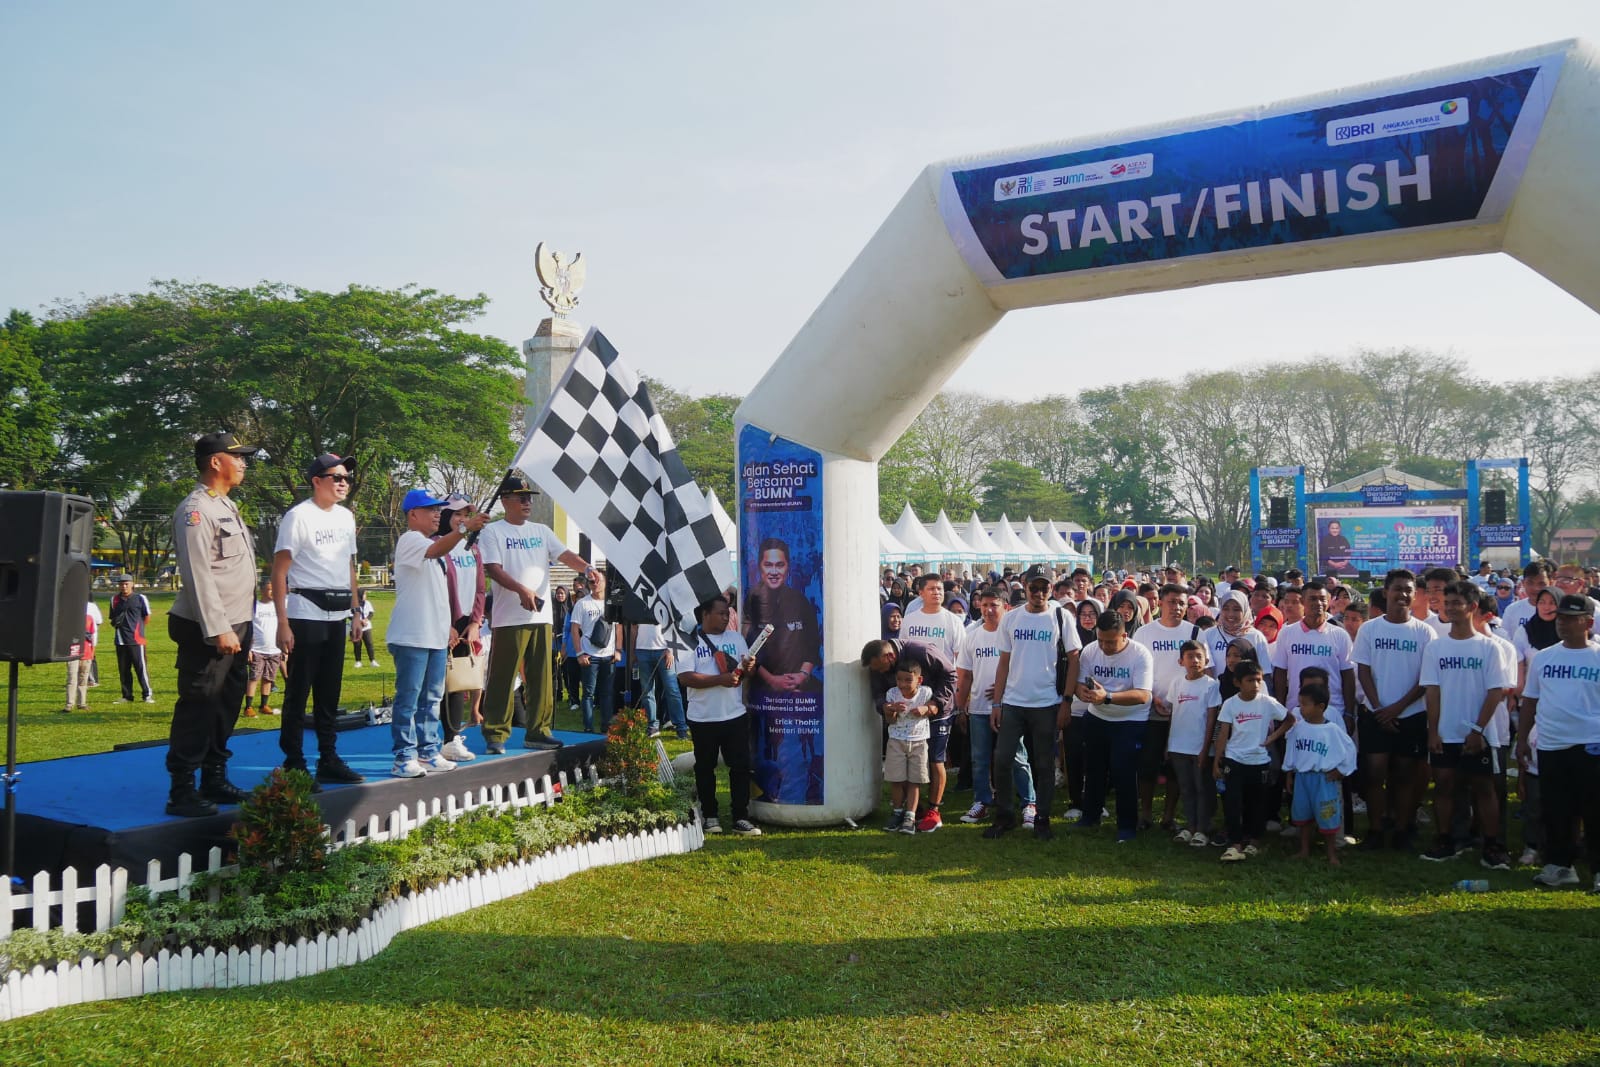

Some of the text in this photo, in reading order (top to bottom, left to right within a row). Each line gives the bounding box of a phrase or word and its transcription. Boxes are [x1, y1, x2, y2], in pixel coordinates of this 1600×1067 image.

[1351, 122, 1374, 137] BRI
[1382, 120, 1414, 130] ANGKASA
[1415, 116, 1433, 124] PURA
[1020, 155, 1432, 255] START/FINISH
[742, 462, 814, 477] Jalan Sehat
[747, 476, 803, 488] Bersama
[754, 487, 793, 499] BUMN
[1398, 526, 1444, 534] MINGGU
[1398, 534, 1417, 546] 26
[1421, 534, 1448, 546] FEB
[1398, 546, 1456, 554] 2023 SUMUT
[908, 625, 945, 638] AKHLAK
[1013, 629, 1052, 642] AKHLAK
[1291, 643, 1332, 656] AKHLAK
[1374, 638, 1418, 653] AKHLAK
[1439, 657, 1483, 670] AKHLAK
[1094, 665, 1130, 678] AKHLAK
[1543, 664, 1600, 682] AKHLAK
[795, 718, 820, 726] Thohir
